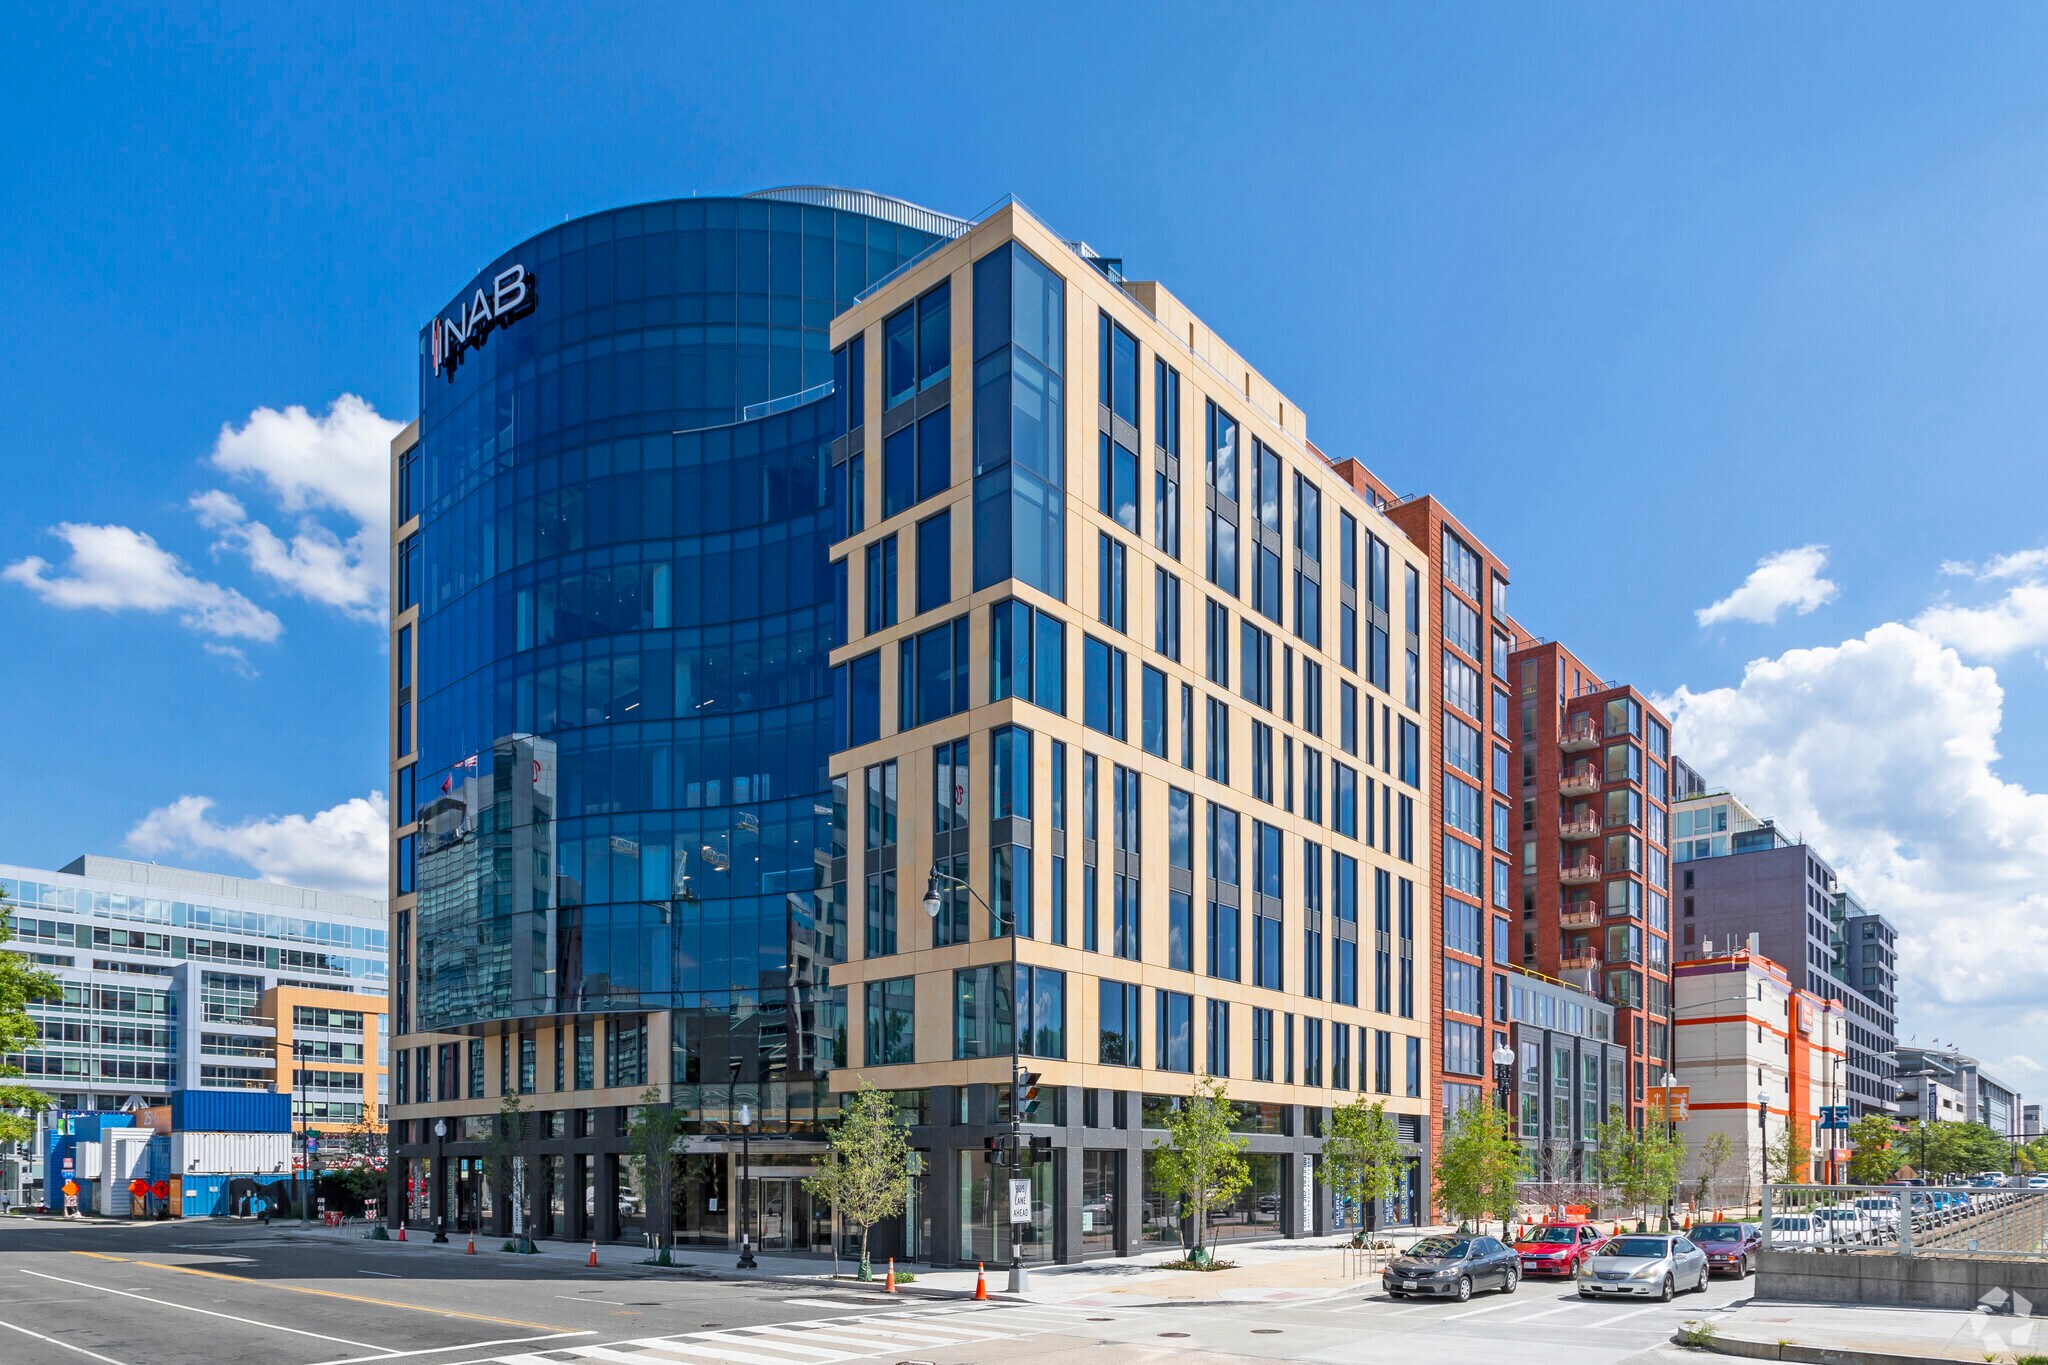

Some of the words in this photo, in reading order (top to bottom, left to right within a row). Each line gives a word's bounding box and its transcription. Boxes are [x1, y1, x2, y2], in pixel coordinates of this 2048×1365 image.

[444, 264, 527, 359] NAB
[1015, 1184, 1025, 1193] BUS
[1015, 1196, 1026, 1205] LANE
[1013, 1208, 1028, 1217] AHEAD
